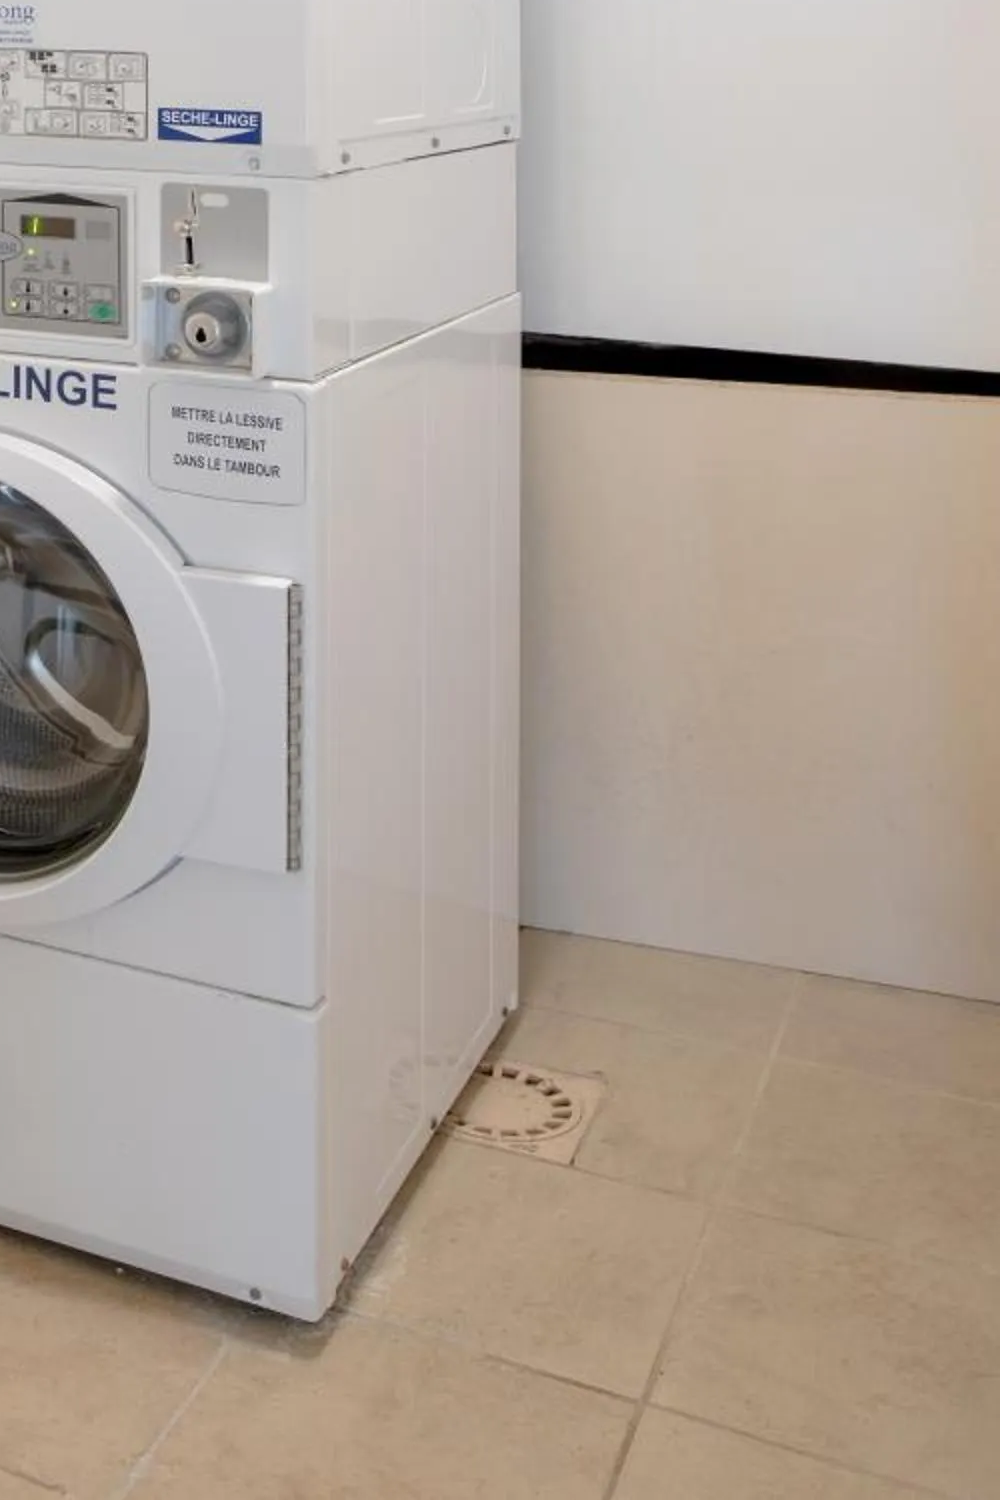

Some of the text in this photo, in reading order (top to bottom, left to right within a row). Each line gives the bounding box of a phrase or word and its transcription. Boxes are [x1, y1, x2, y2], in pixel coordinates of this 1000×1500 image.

[161, 109, 259, 127] SECHE-LINGE
[171, 406, 283, 431] METTRE LA LESSIVE
[187, 431, 266, 452] DIRECTEMENT
[172, 453, 281, 478] DANS LE TAMBOUR
